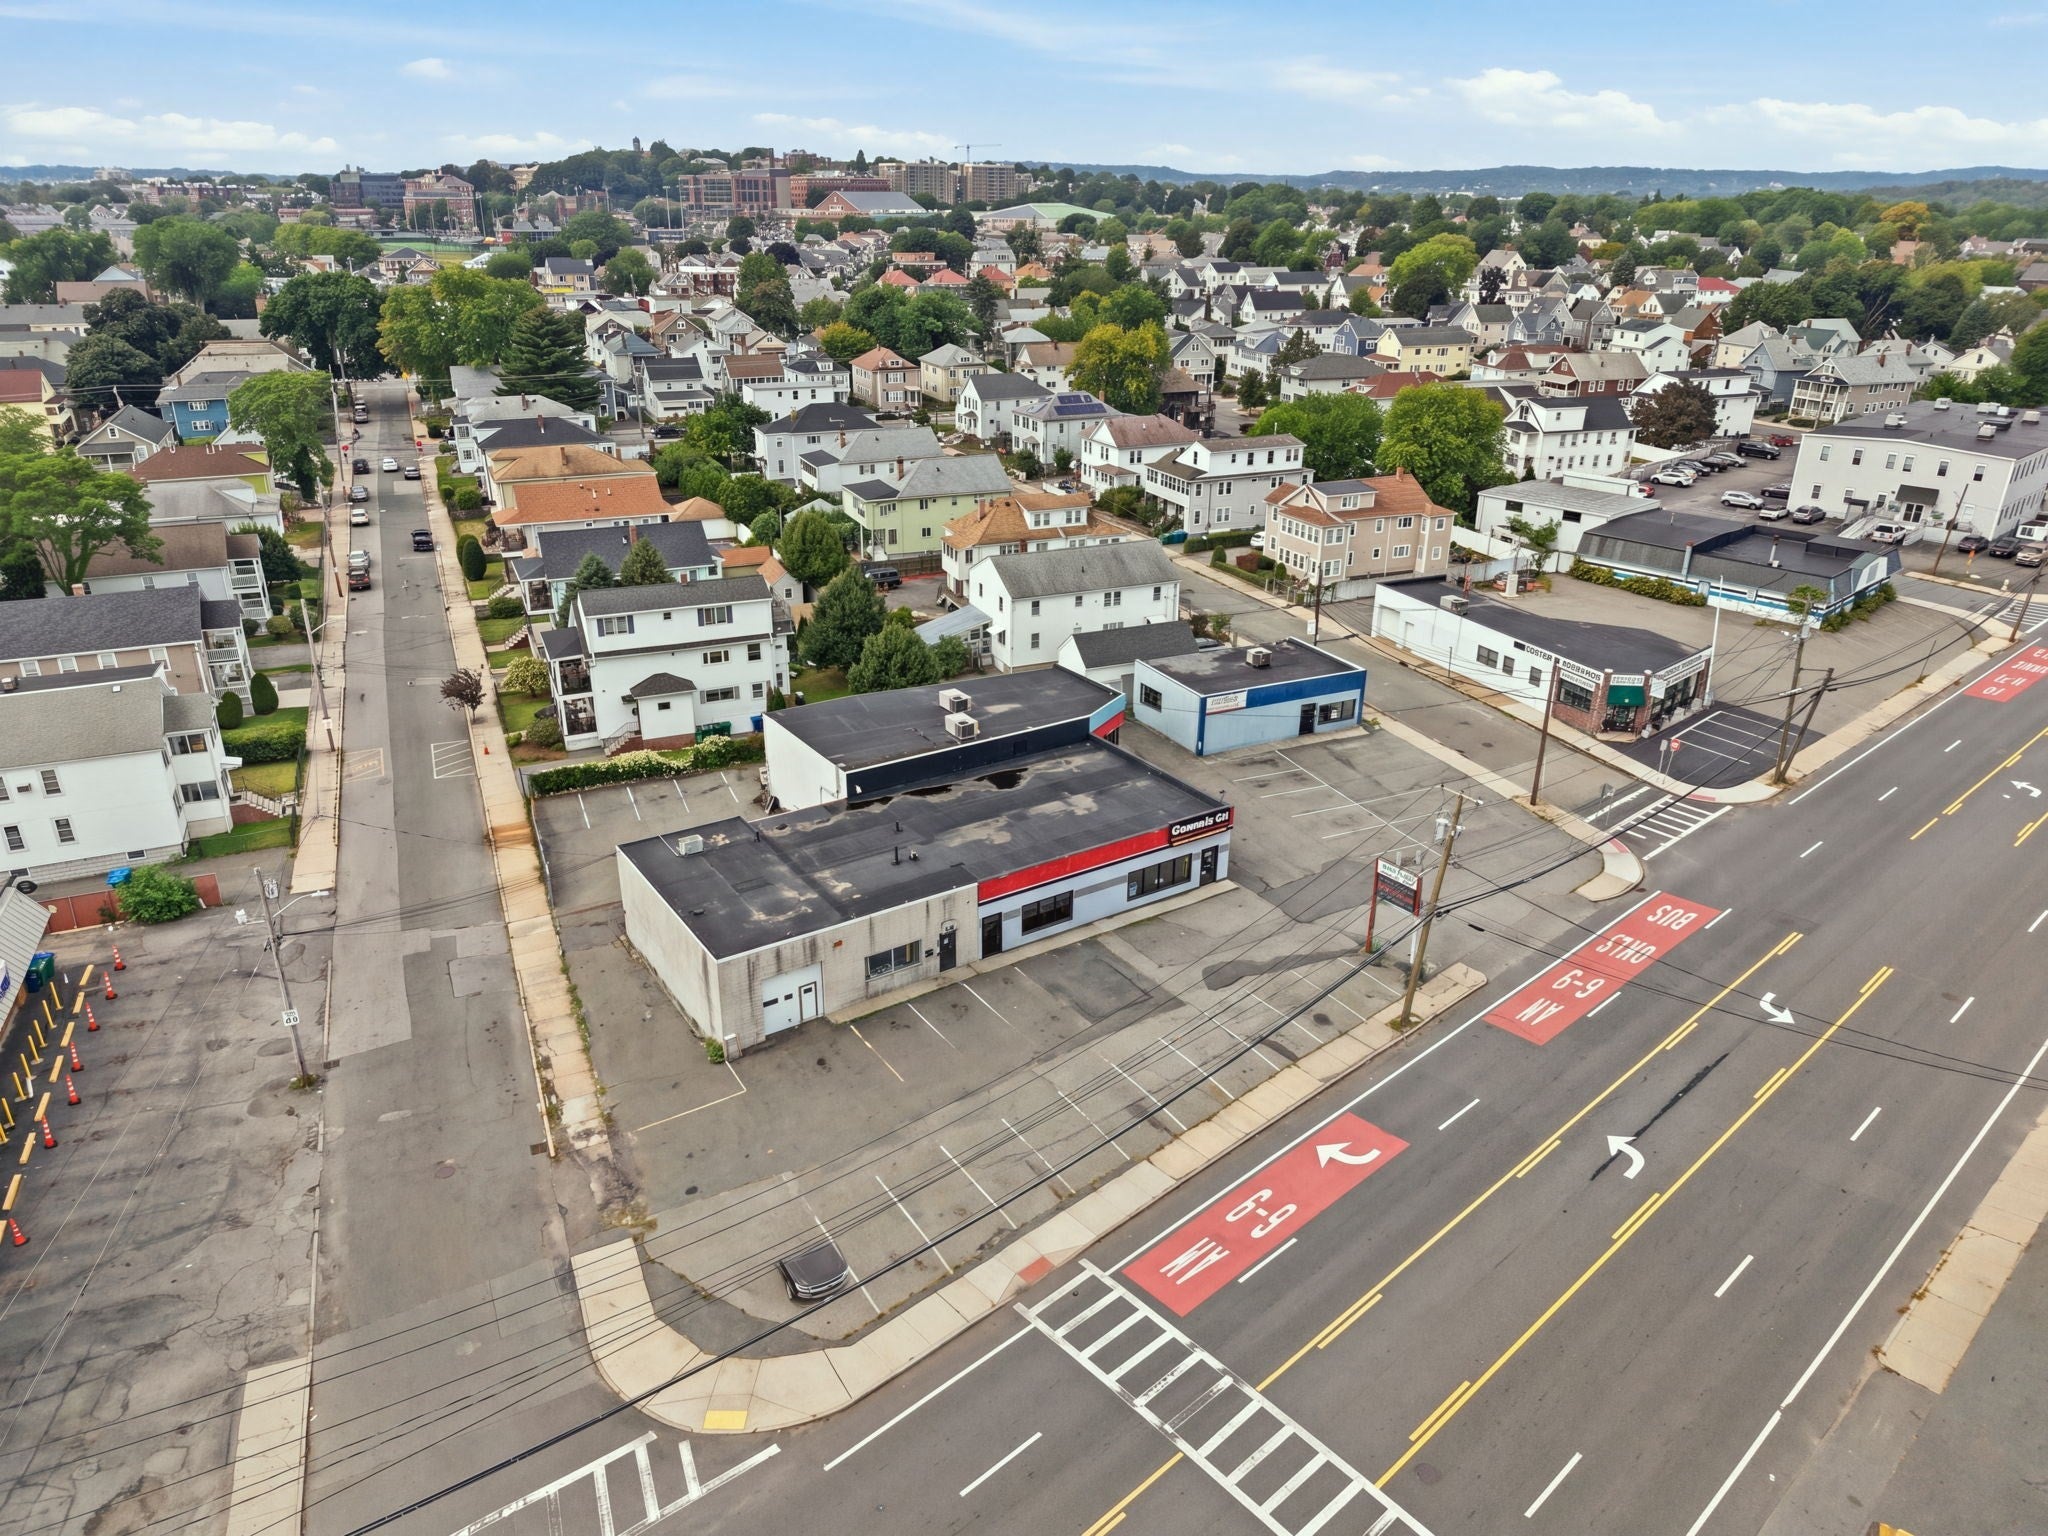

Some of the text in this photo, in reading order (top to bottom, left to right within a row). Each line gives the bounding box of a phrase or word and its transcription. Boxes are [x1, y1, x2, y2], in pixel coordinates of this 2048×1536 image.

[1647, 904, 1698, 930] BUS
[1552, 969, 1605, 998] 6-9
[1225, 1188, 1298, 1239] 6-9
